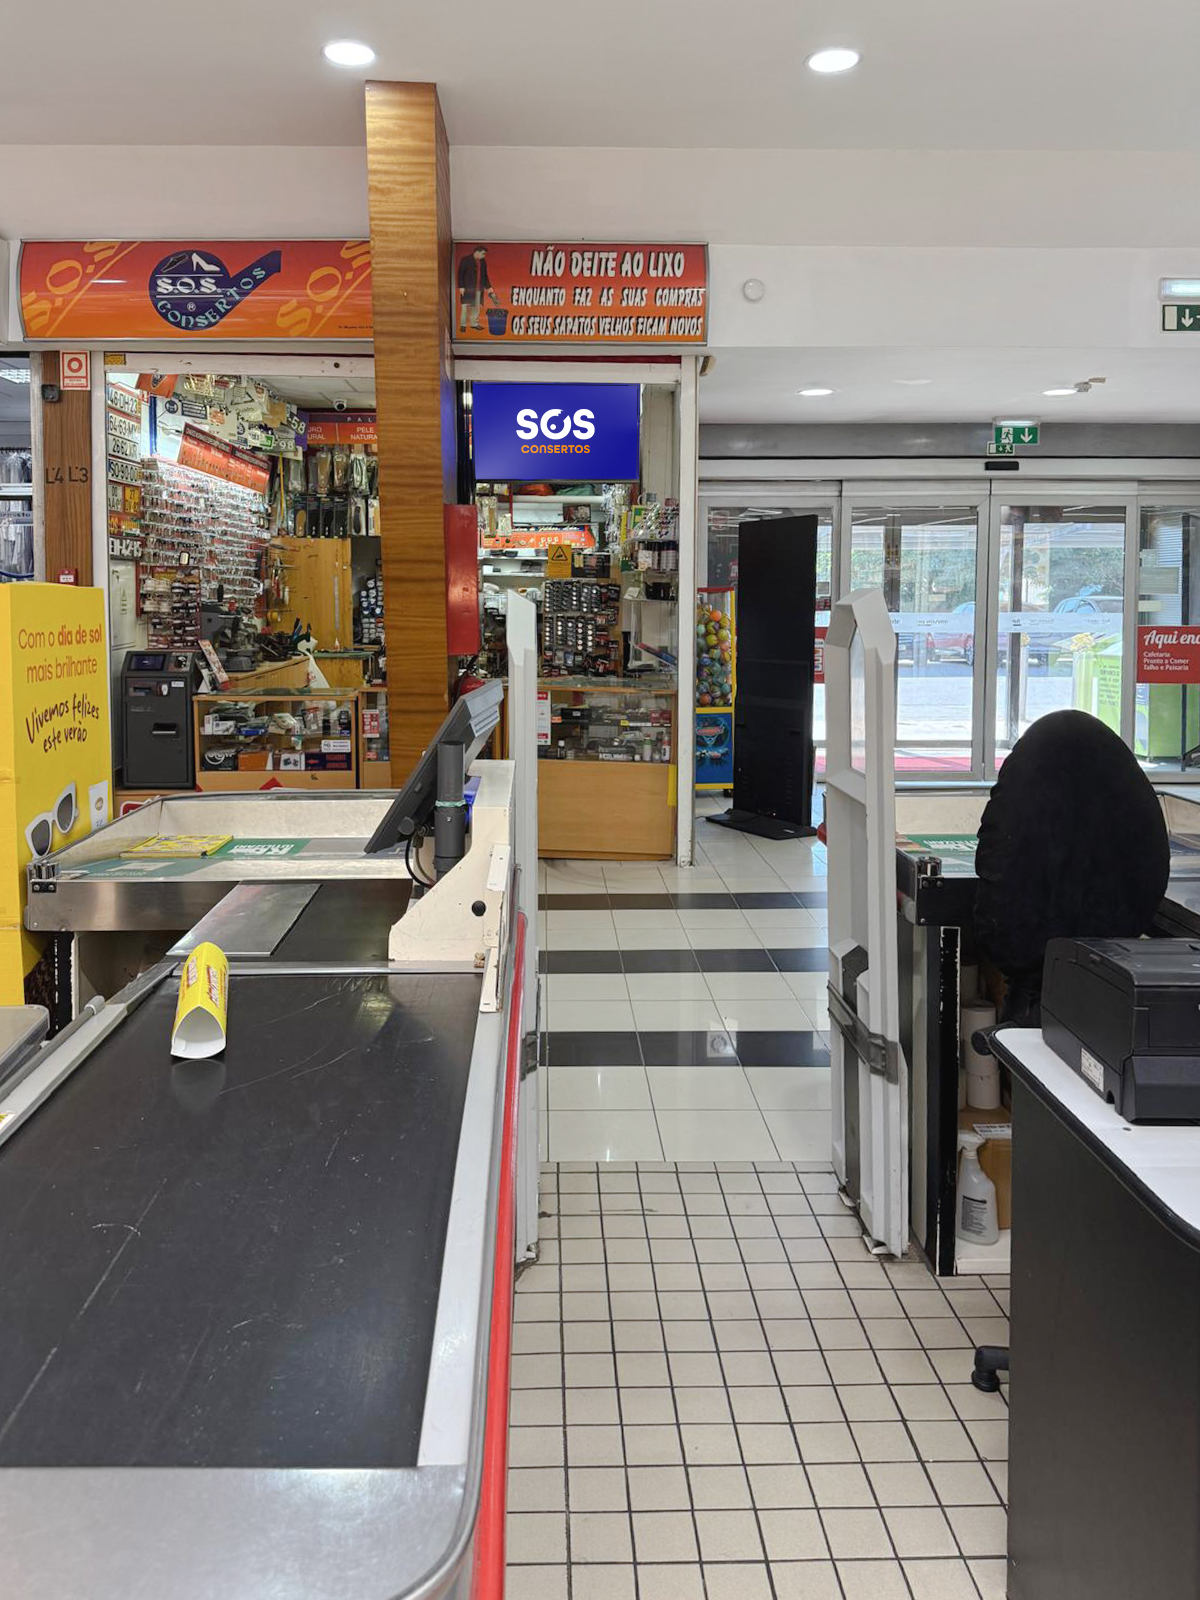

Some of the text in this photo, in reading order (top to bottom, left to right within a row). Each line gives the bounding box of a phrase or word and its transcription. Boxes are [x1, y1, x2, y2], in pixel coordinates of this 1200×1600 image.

[530, 246, 684, 277] NÃO DEITE AO LIXO
[511, 286, 705, 308] ENQUANTO FAZ AS SUAS COMPRAS
[511, 316, 703, 337] OS SEUS SAPATOS VELHOS FICAM NOVOS
[515, 408, 596, 440] SOS
[520, 444, 591, 454] CONSERTOS
[18, 623, 102, 649] Com o dia de sol
[1143, 629, 1179, 649] Aqui
[27, 655, 98, 683] mais brilhante
[25, 692, 99, 745] Vivemos felizes
[43, 720, 88, 753] este verão
